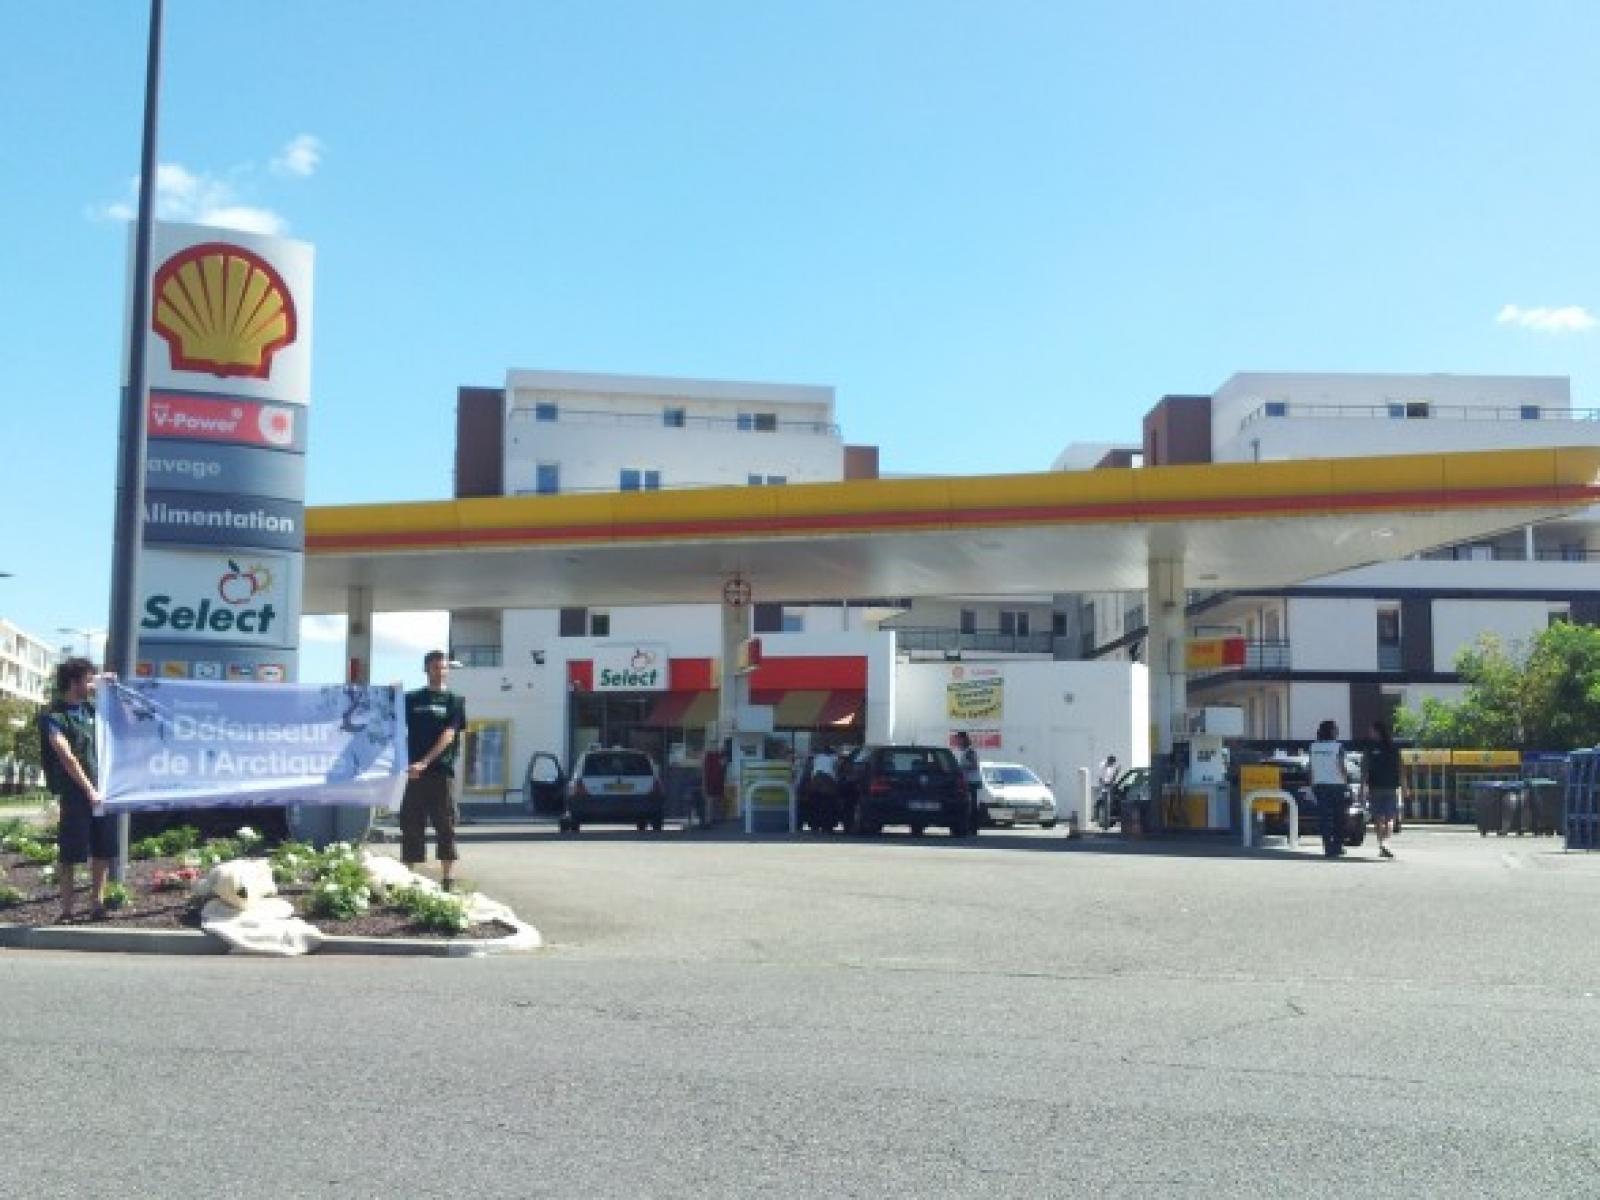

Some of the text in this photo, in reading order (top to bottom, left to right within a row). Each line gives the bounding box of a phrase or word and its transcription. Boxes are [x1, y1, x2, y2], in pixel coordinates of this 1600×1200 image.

[152, 406, 238, 433] V-Power
[146, 458, 221, 480] avage
[141, 595, 276, 634] Select
[600, 668, 657, 687] Select
[149, 748, 190, 776] de
